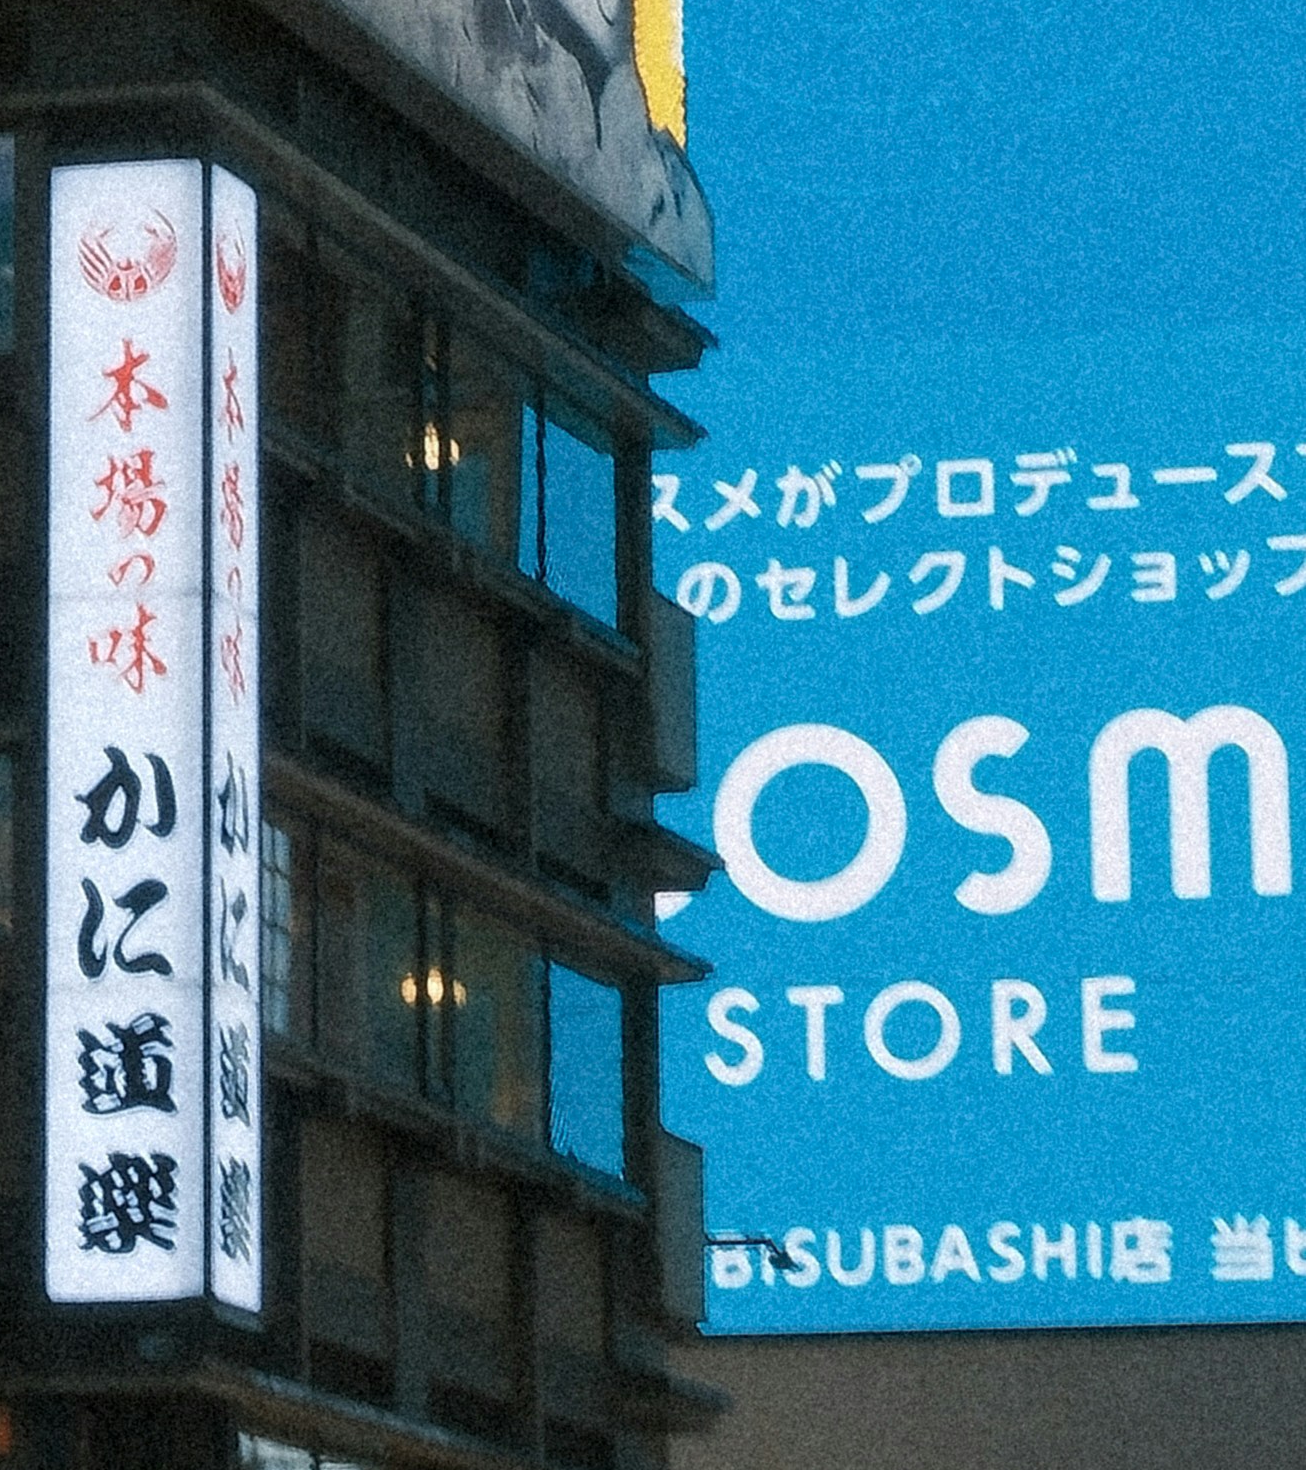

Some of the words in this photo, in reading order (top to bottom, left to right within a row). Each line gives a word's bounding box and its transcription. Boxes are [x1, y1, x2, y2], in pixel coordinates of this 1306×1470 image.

[85, 337, 173, 699] 本場の味
[652, 440, 1306, 533] スメがプロデュース
[656, 703, 1294, 923] osm
[702, 973, 1140, 1088] STORE
